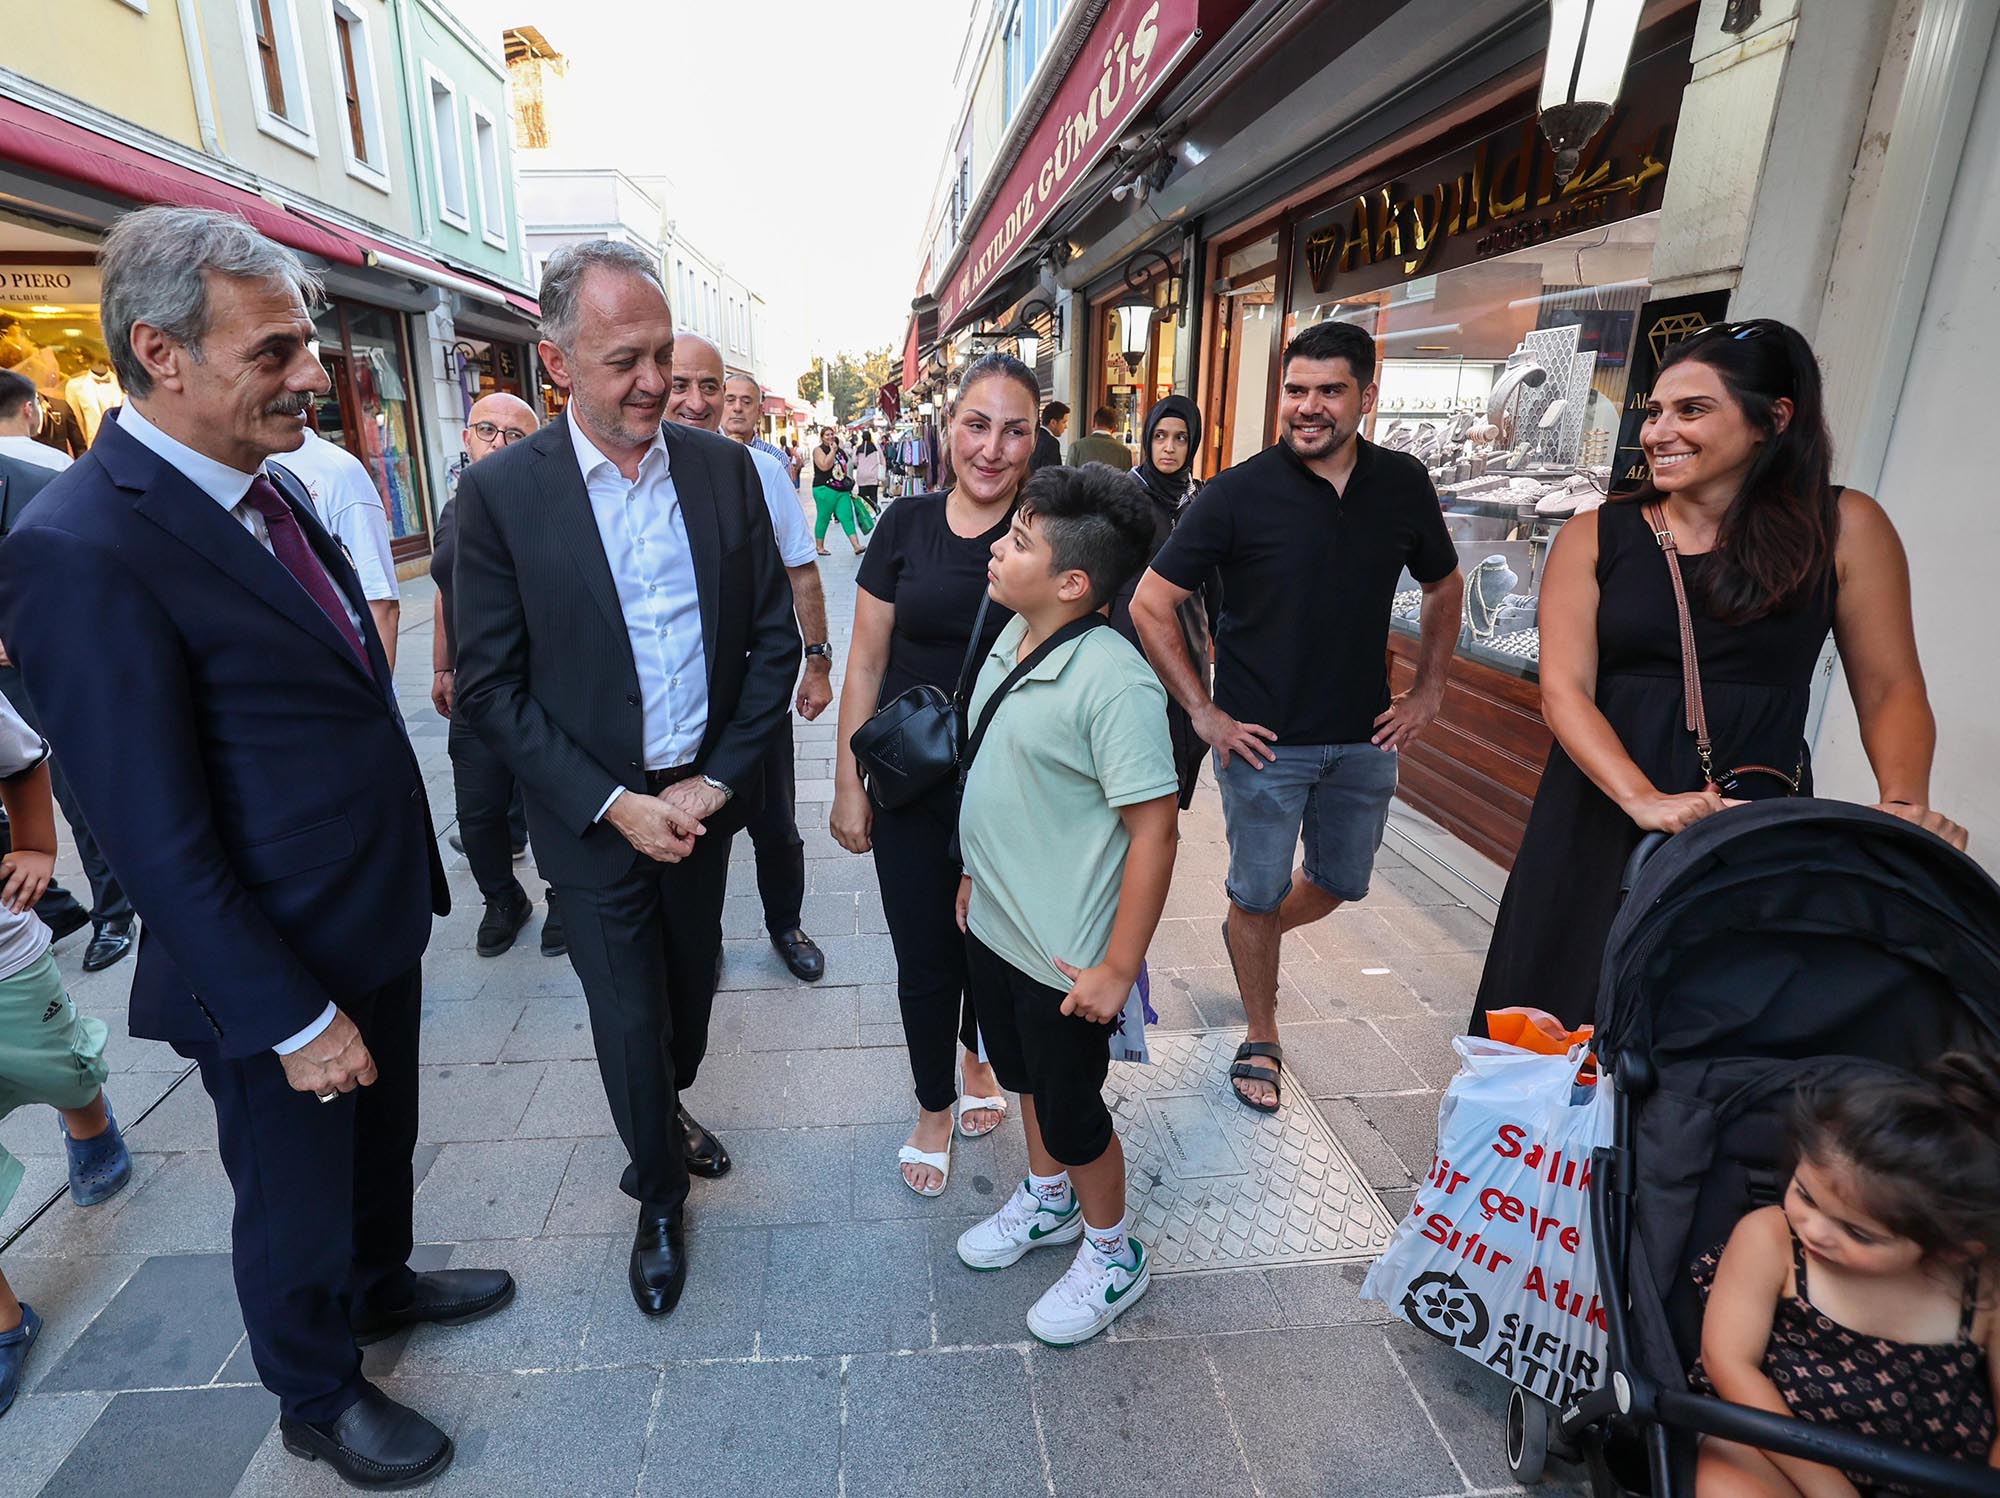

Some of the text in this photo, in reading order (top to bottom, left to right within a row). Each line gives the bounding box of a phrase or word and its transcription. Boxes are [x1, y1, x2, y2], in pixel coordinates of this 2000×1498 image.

[971, 2, 1160, 292] AKYILDIZ GÜMÜŞ
[11, 273, 71, 288] PIERO
[1523, 1265, 1609, 1333] Atık
[1497, 1313, 1600, 1387] SIFIR
